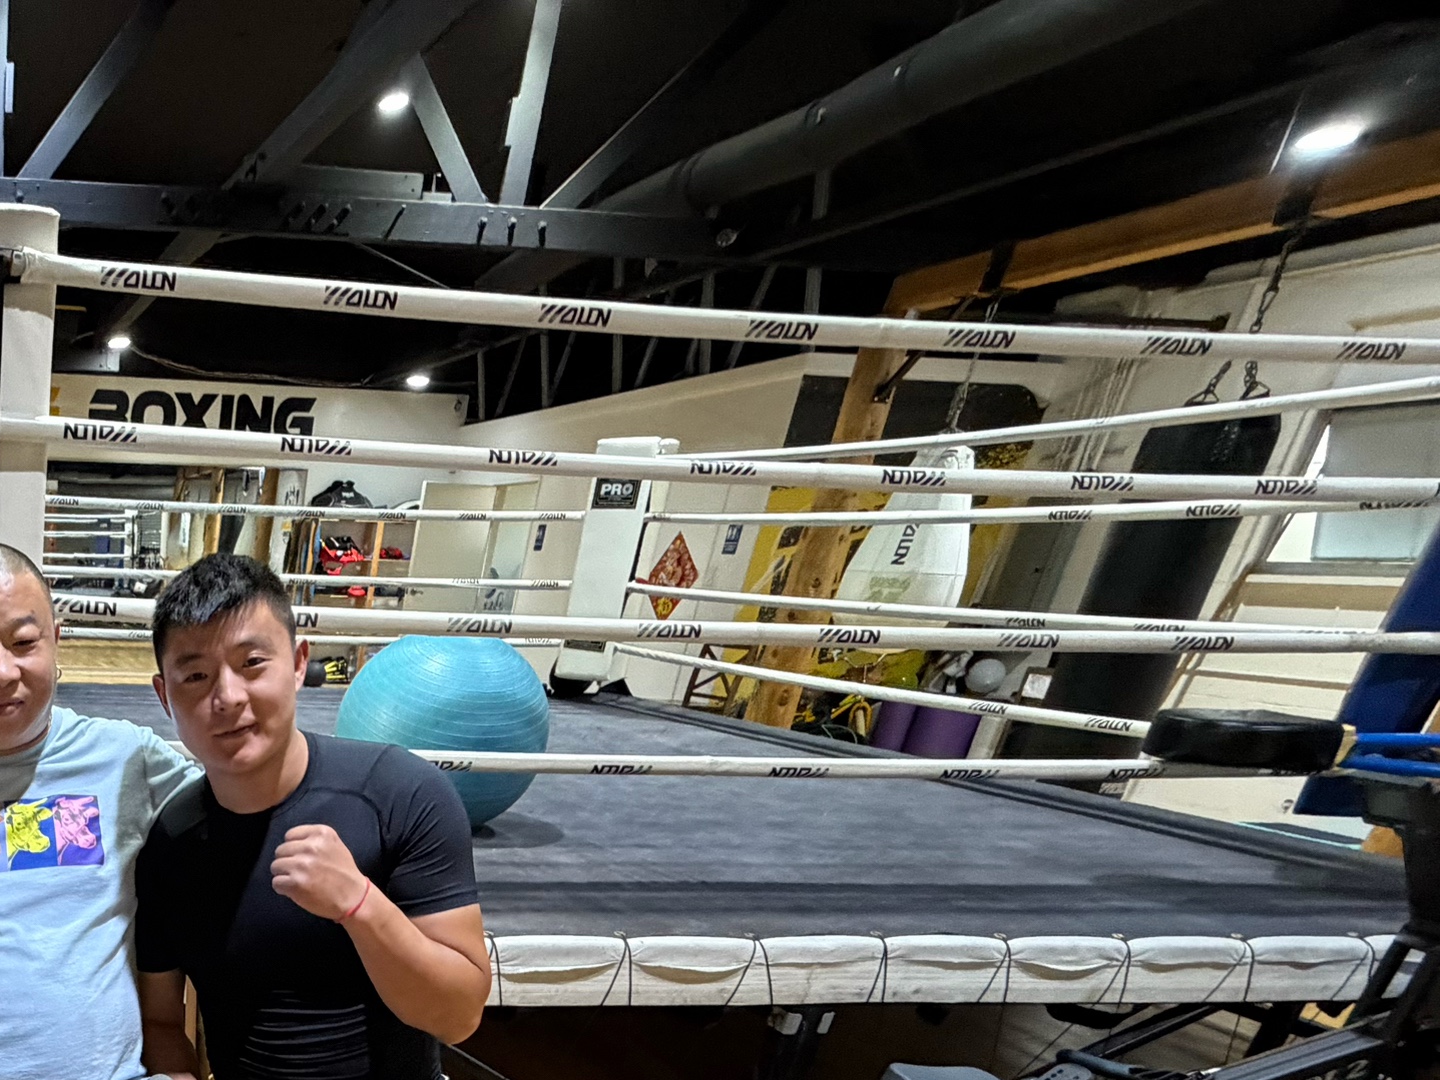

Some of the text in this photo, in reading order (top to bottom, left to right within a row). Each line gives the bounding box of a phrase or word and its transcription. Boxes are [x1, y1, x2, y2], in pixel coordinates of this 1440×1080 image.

[88, 389, 317, 436] BOXING
[600, 483, 634, 496] PRO
[1345, 1058, 1371, 1080] 2
